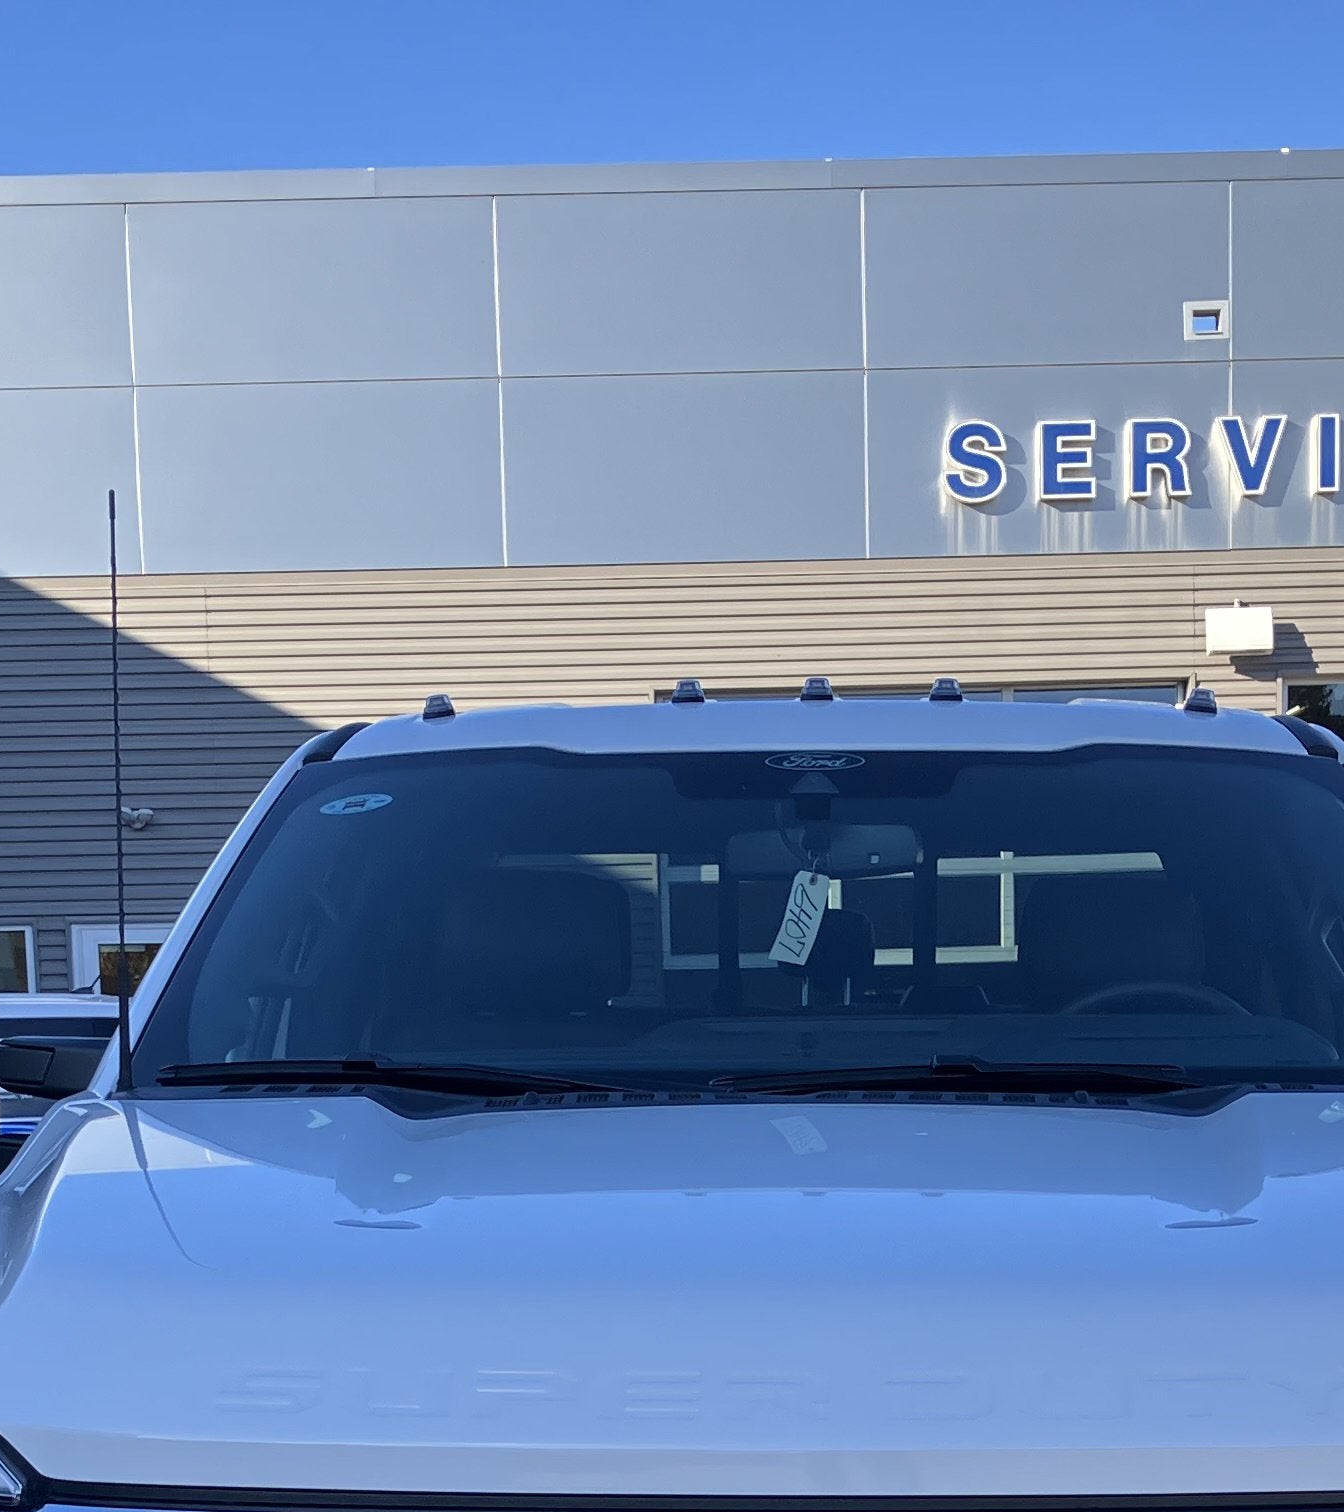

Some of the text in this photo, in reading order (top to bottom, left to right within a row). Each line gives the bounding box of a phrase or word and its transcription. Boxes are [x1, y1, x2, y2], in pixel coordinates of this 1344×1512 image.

[782, 754, 848, 767] Ford
[778, 883, 818, 957] 6407
[210, 1365, 830, 1421] SUPER
